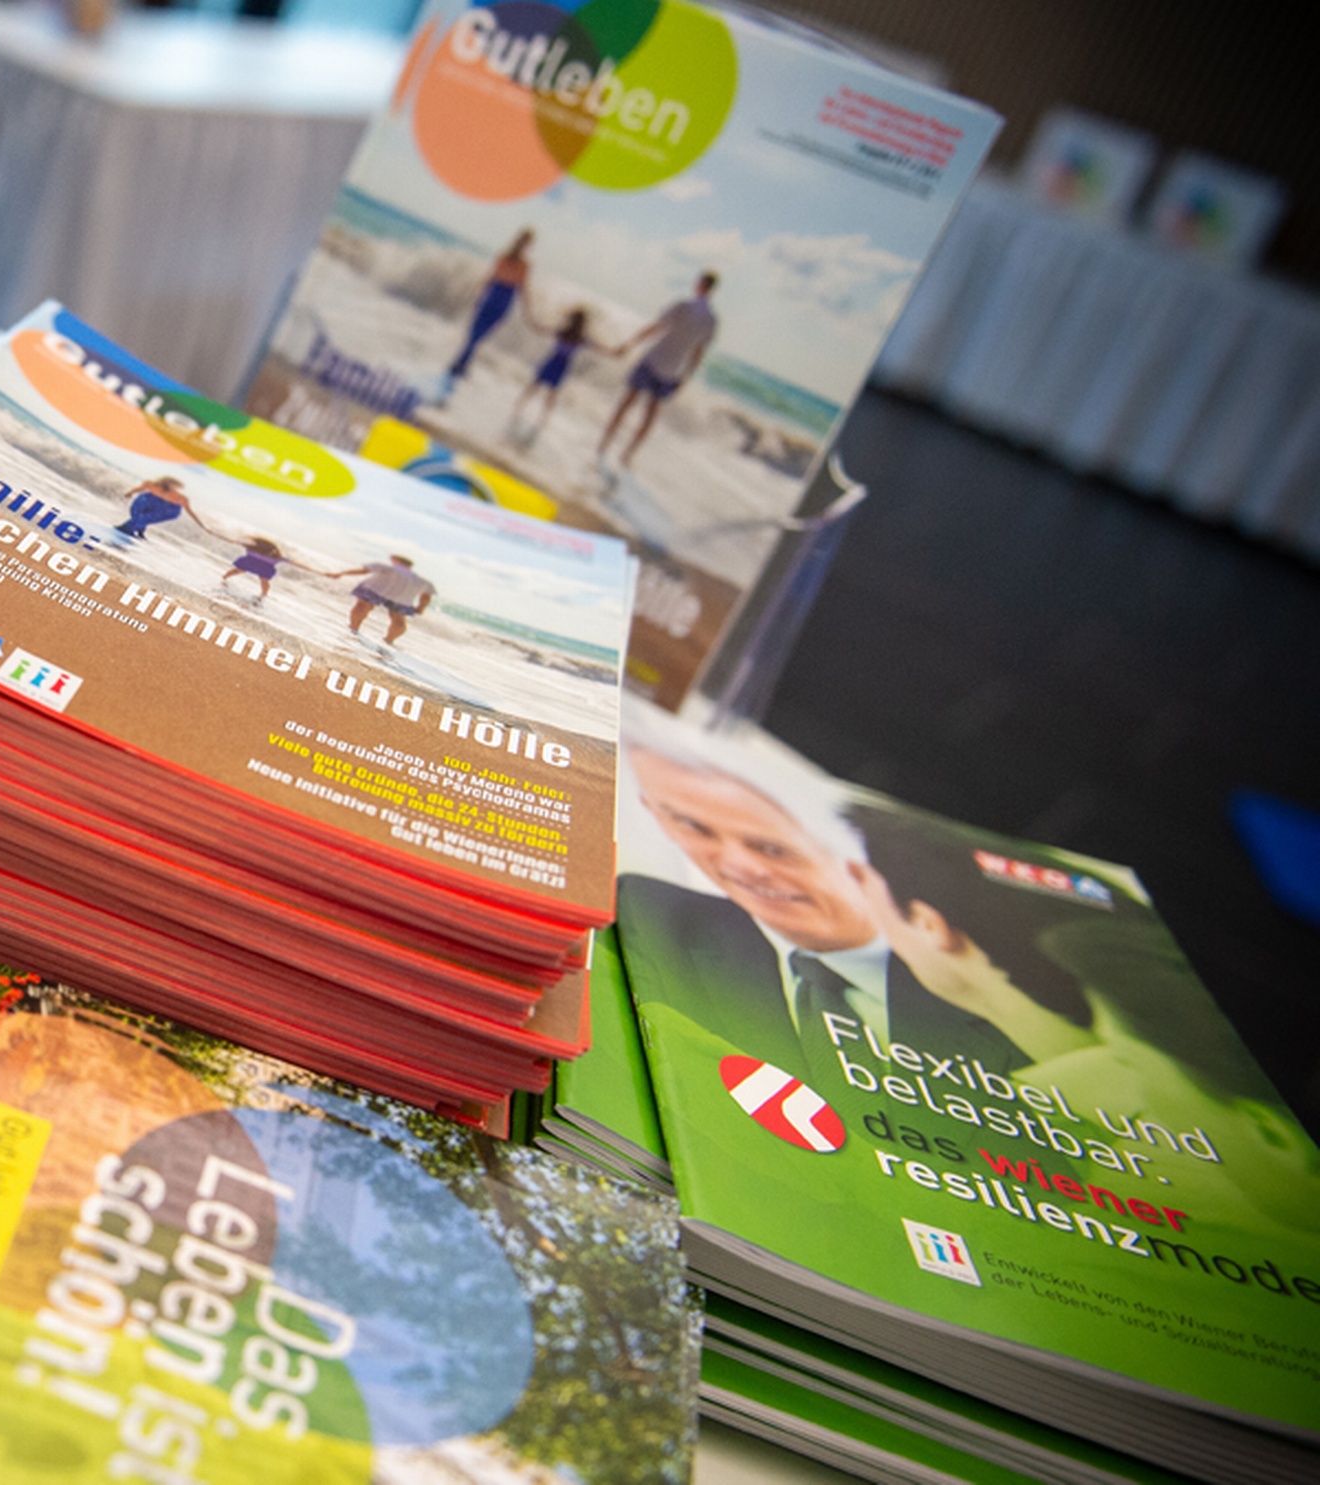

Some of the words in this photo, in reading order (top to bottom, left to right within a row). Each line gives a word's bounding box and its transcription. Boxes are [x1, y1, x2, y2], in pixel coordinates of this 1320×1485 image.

[452, 6, 690, 145] Gutleben
[41, 332, 316, 486] Gutleben
[119, 582, 313, 680] Himmel
[326, 670, 424, 721] und
[439, 707, 572, 768] Hölle
[247, 758, 294, 785] Neue
[295, 777, 378, 817] Initiative
[380, 808, 409, 827] für
[410, 817, 440, 838] die
[268, 733, 311, 758] Viele
[313, 751, 354, 774] gute
[426, 792, 455, 810] die
[284, 720, 314, 738] der
[316, 731, 405, 773] Begründer
[408, 766, 439, 784] des
[442, 777, 572, 825] Psychodramas
[312, 763, 405, 806] Betreuung
[407, 799, 472, 827] massiv
[474, 821, 495, 835] zu
[373, 743, 425, 768] Jacob
[429, 761, 467, 782] Levy
[470, 774, 536, 803] Moreno
[539, 796, 572, 812] war
[391, 825, 424, 846] Gut
[425, 836, 479, 864] leben
[481, 853, 507, 873] im
[822, 1010, 1081, 1124] Flexibel
[1095, 1107, 1223, 1164] und
[862, 1110, 966, 1164] das
[977, 1148, 1189, 1232] wiener
[14, 1152, 169, 1420] schön!
[144, 1154, 296, 1384] Leben
[983, 1251, 1090, 1293] Entwickelt
[1095, 1289, 1130, 1308] von
[1133, 1300, 1171, 1321] den
[991, 1272, 1025, 1290] der
[1118, 1314, 1159, 1334] und
[230, 1284, 357, 1441] Das
